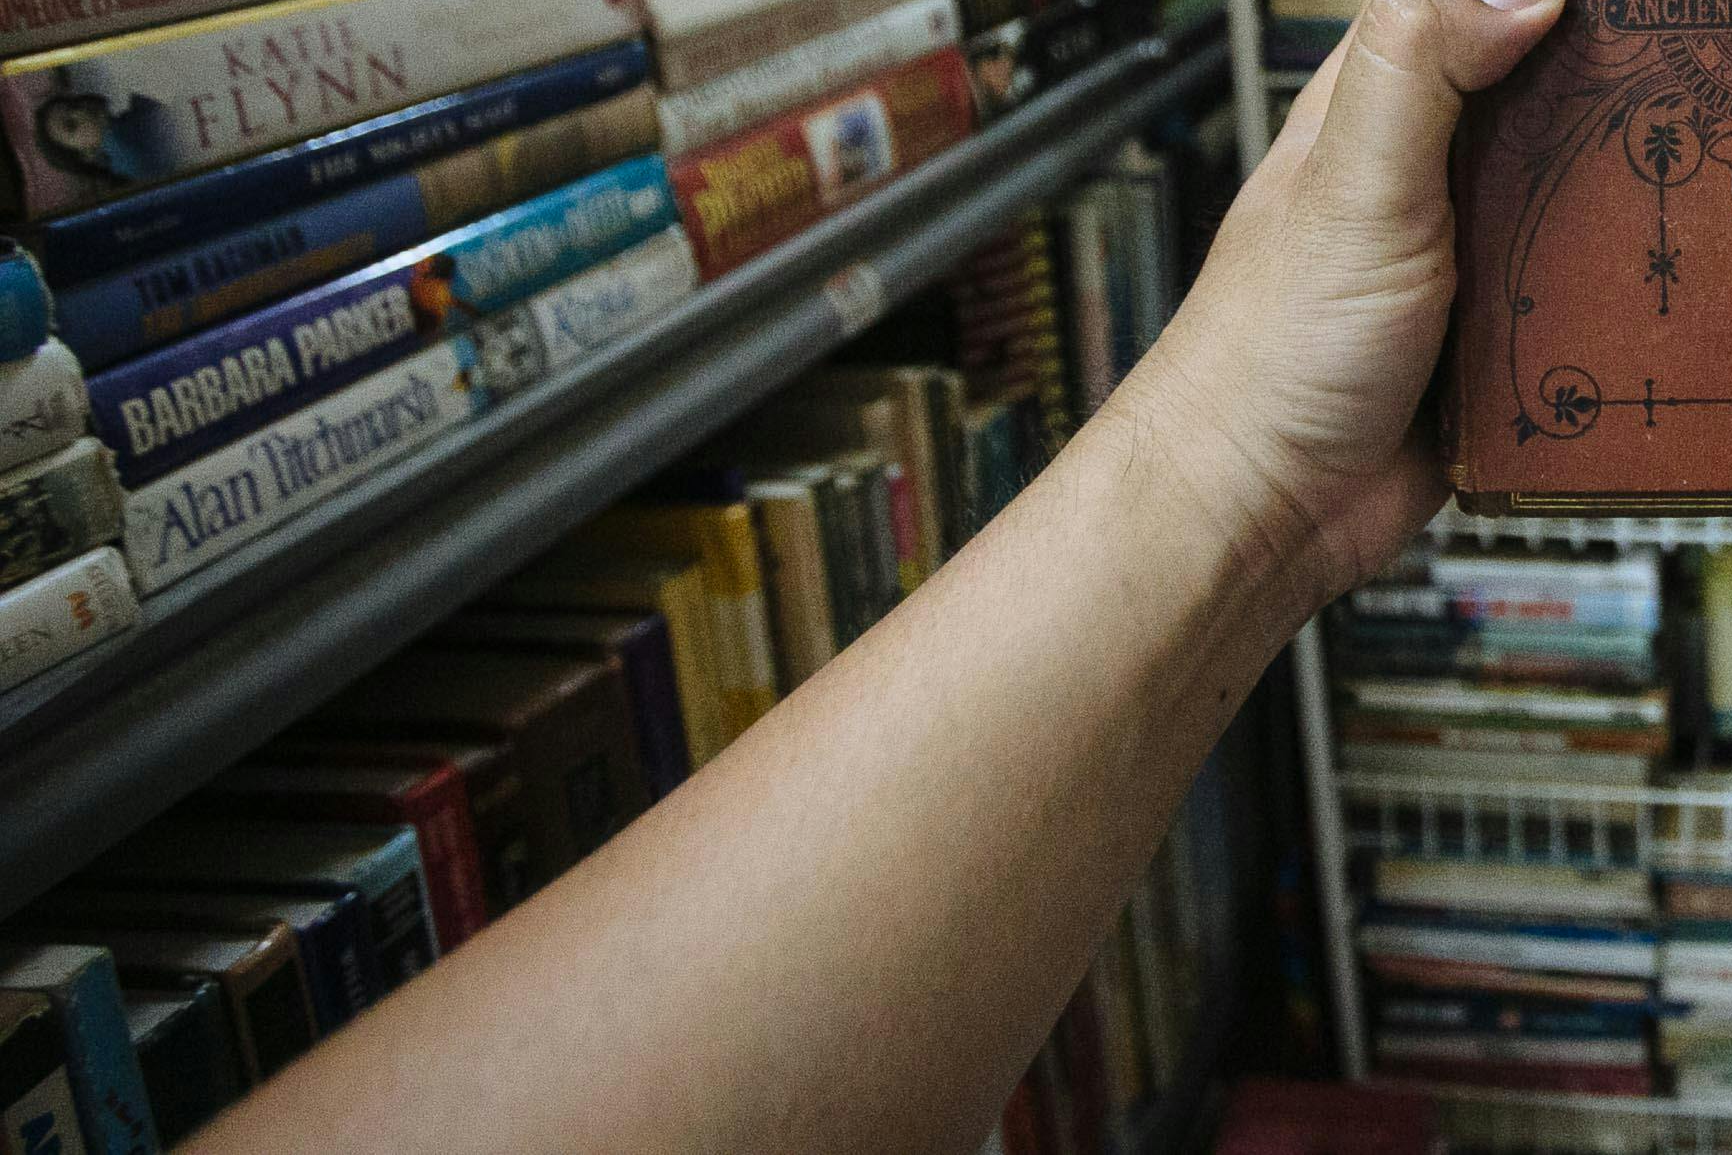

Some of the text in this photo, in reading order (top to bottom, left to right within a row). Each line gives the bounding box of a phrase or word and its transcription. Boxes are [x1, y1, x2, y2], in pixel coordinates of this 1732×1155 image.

[190, 46, 407, 149] FLYNN
[118, 284, 417, 458] BARBARA PARKER
[154, 467, 263, 567] Alan
